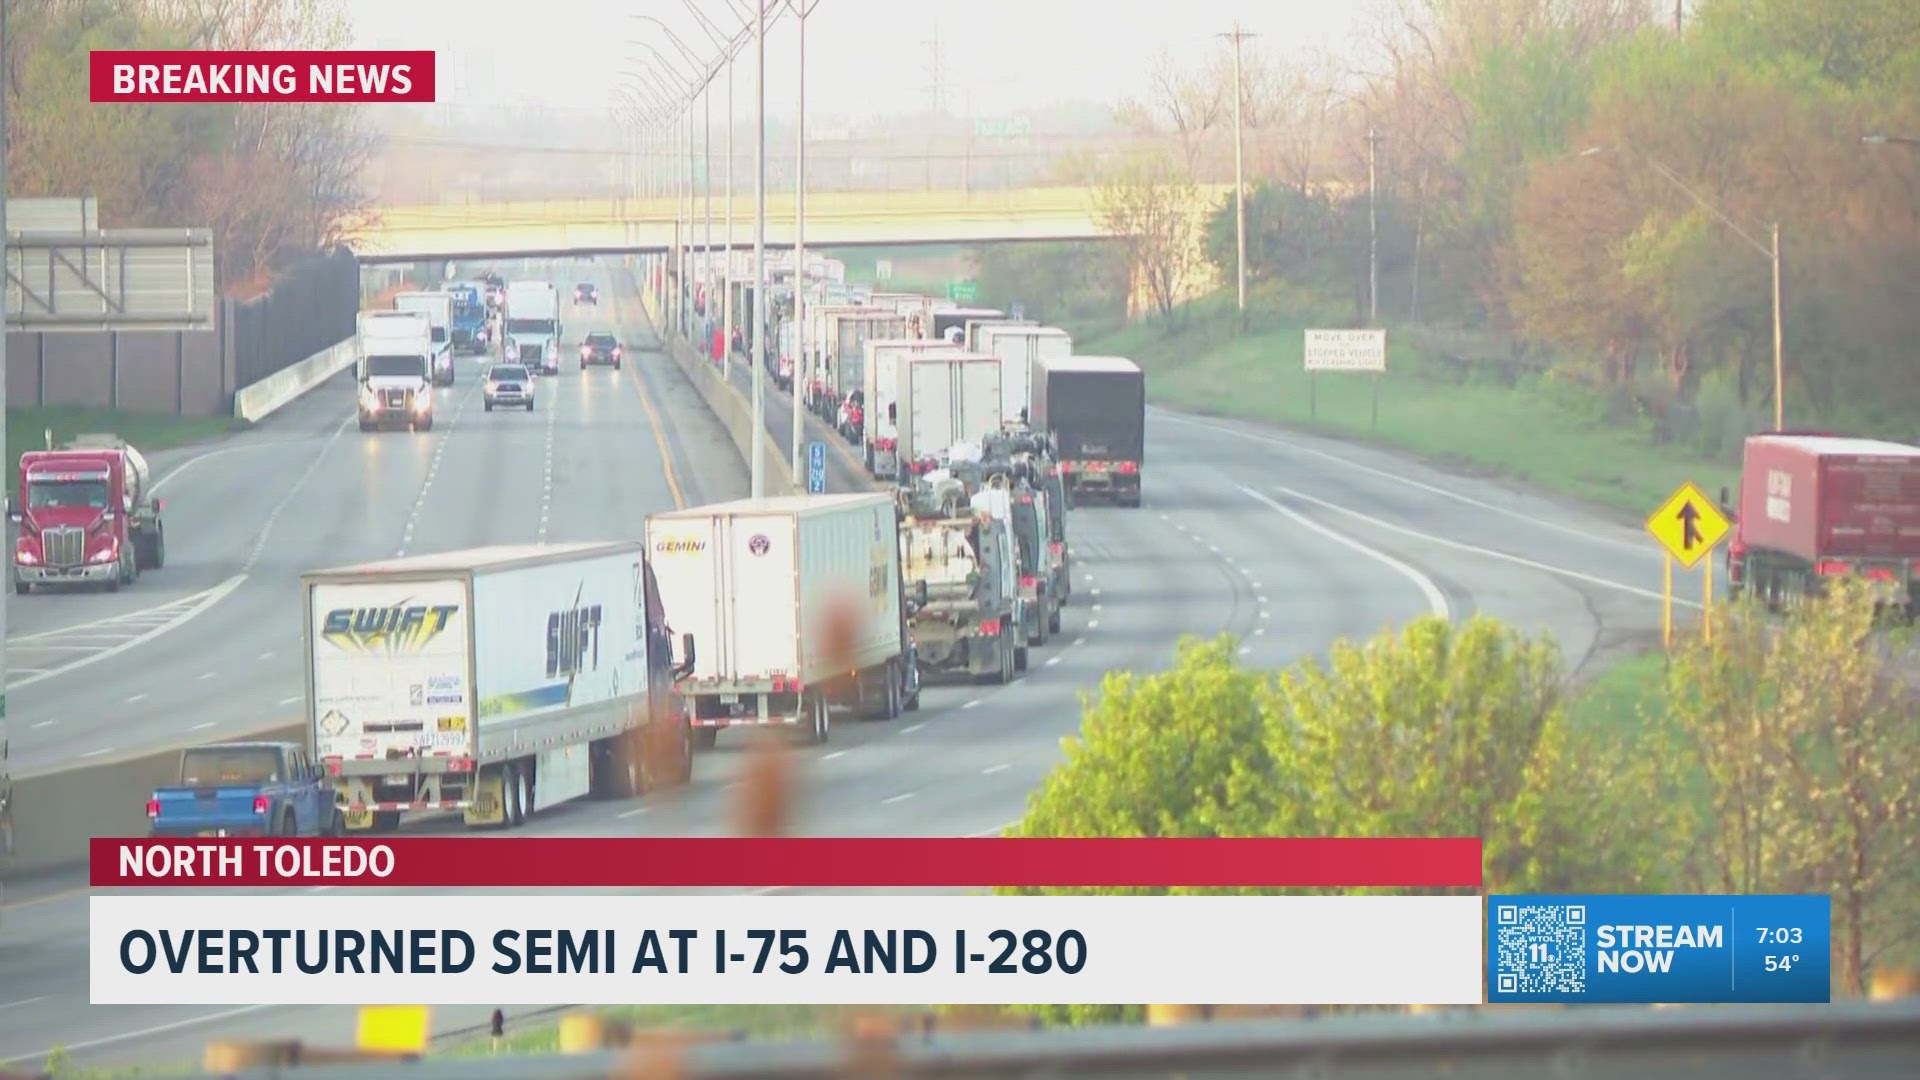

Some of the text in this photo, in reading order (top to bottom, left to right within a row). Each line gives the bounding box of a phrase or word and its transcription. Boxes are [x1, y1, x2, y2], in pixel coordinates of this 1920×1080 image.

[1314, 333, 1375, 341] MOVE OVER
[656, 541, 705, 553] GEMINI
[323, 603, 459, 635] SWIFT
[546, 604, 602, 679] SWIFT
